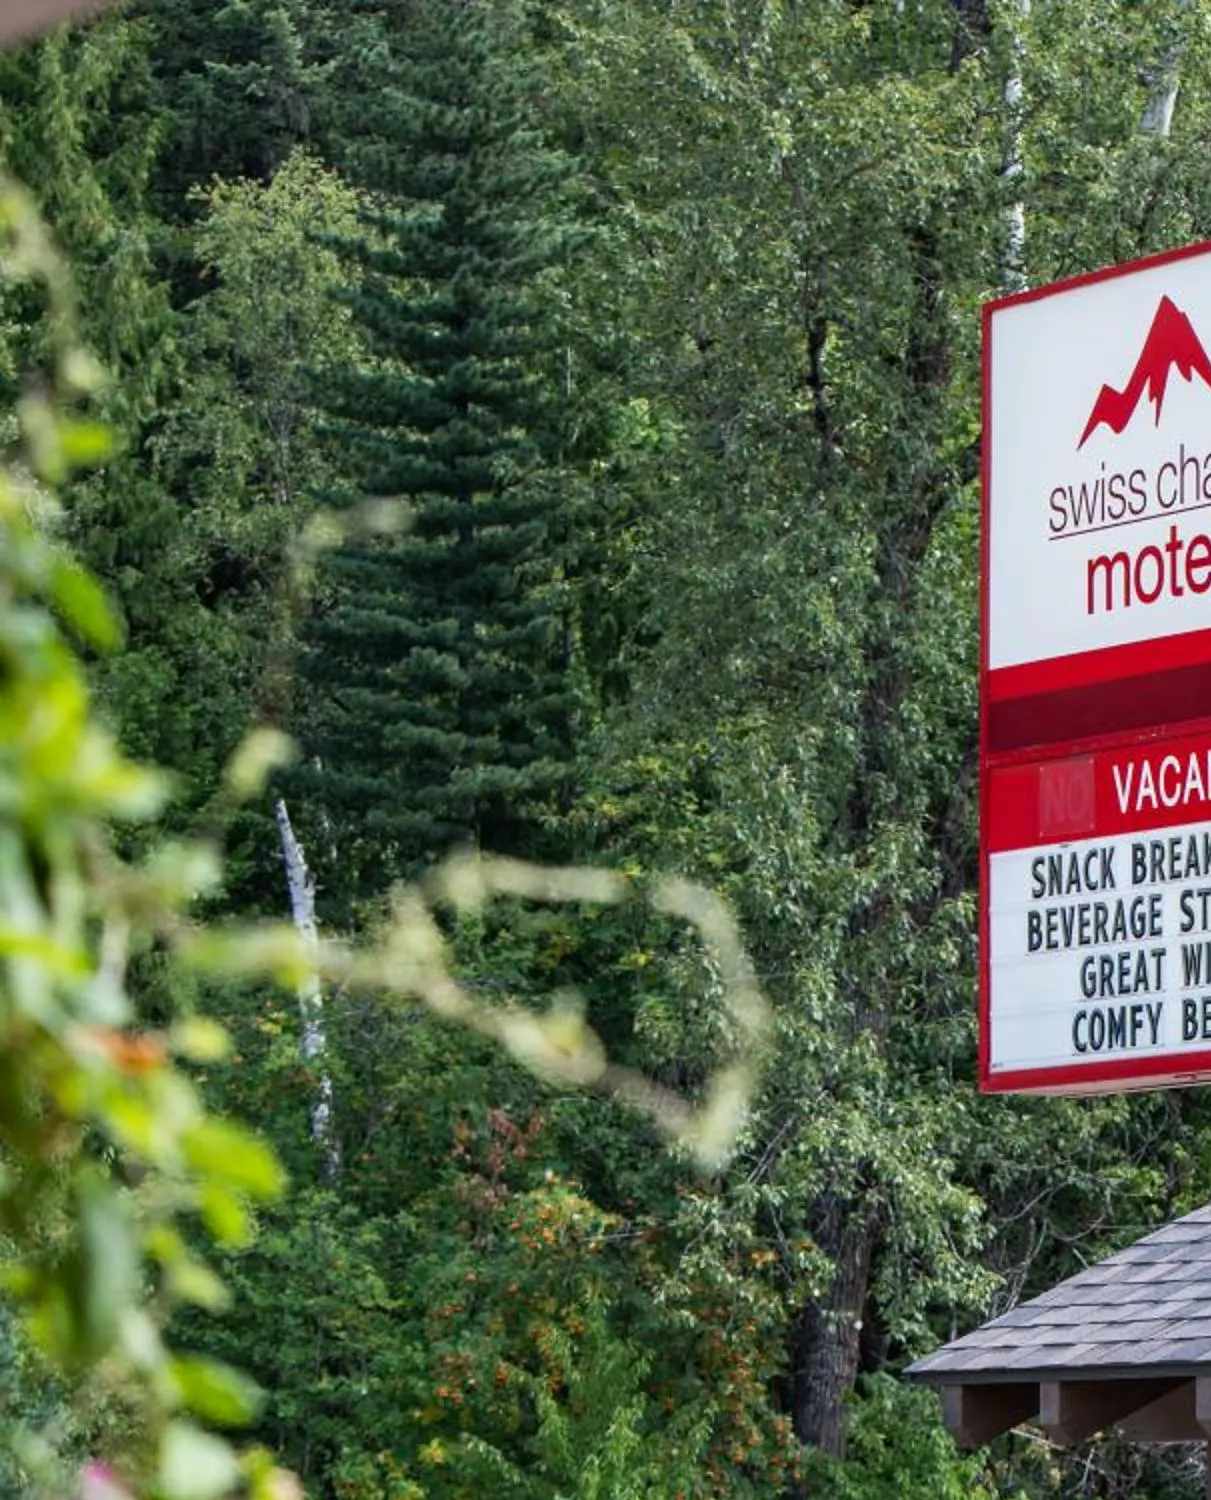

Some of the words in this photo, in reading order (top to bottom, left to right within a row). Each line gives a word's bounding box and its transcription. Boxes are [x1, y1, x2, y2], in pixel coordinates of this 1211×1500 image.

[1049, 461, 1146, 532] swiss
[1031, 846, 1116, 899] SNACK
[1027, 893, 1163, 952] BEVERAGE
[1080, 948, 1167, 998] GREAT
[1072, 1001, 1163, 1053] COMFY
